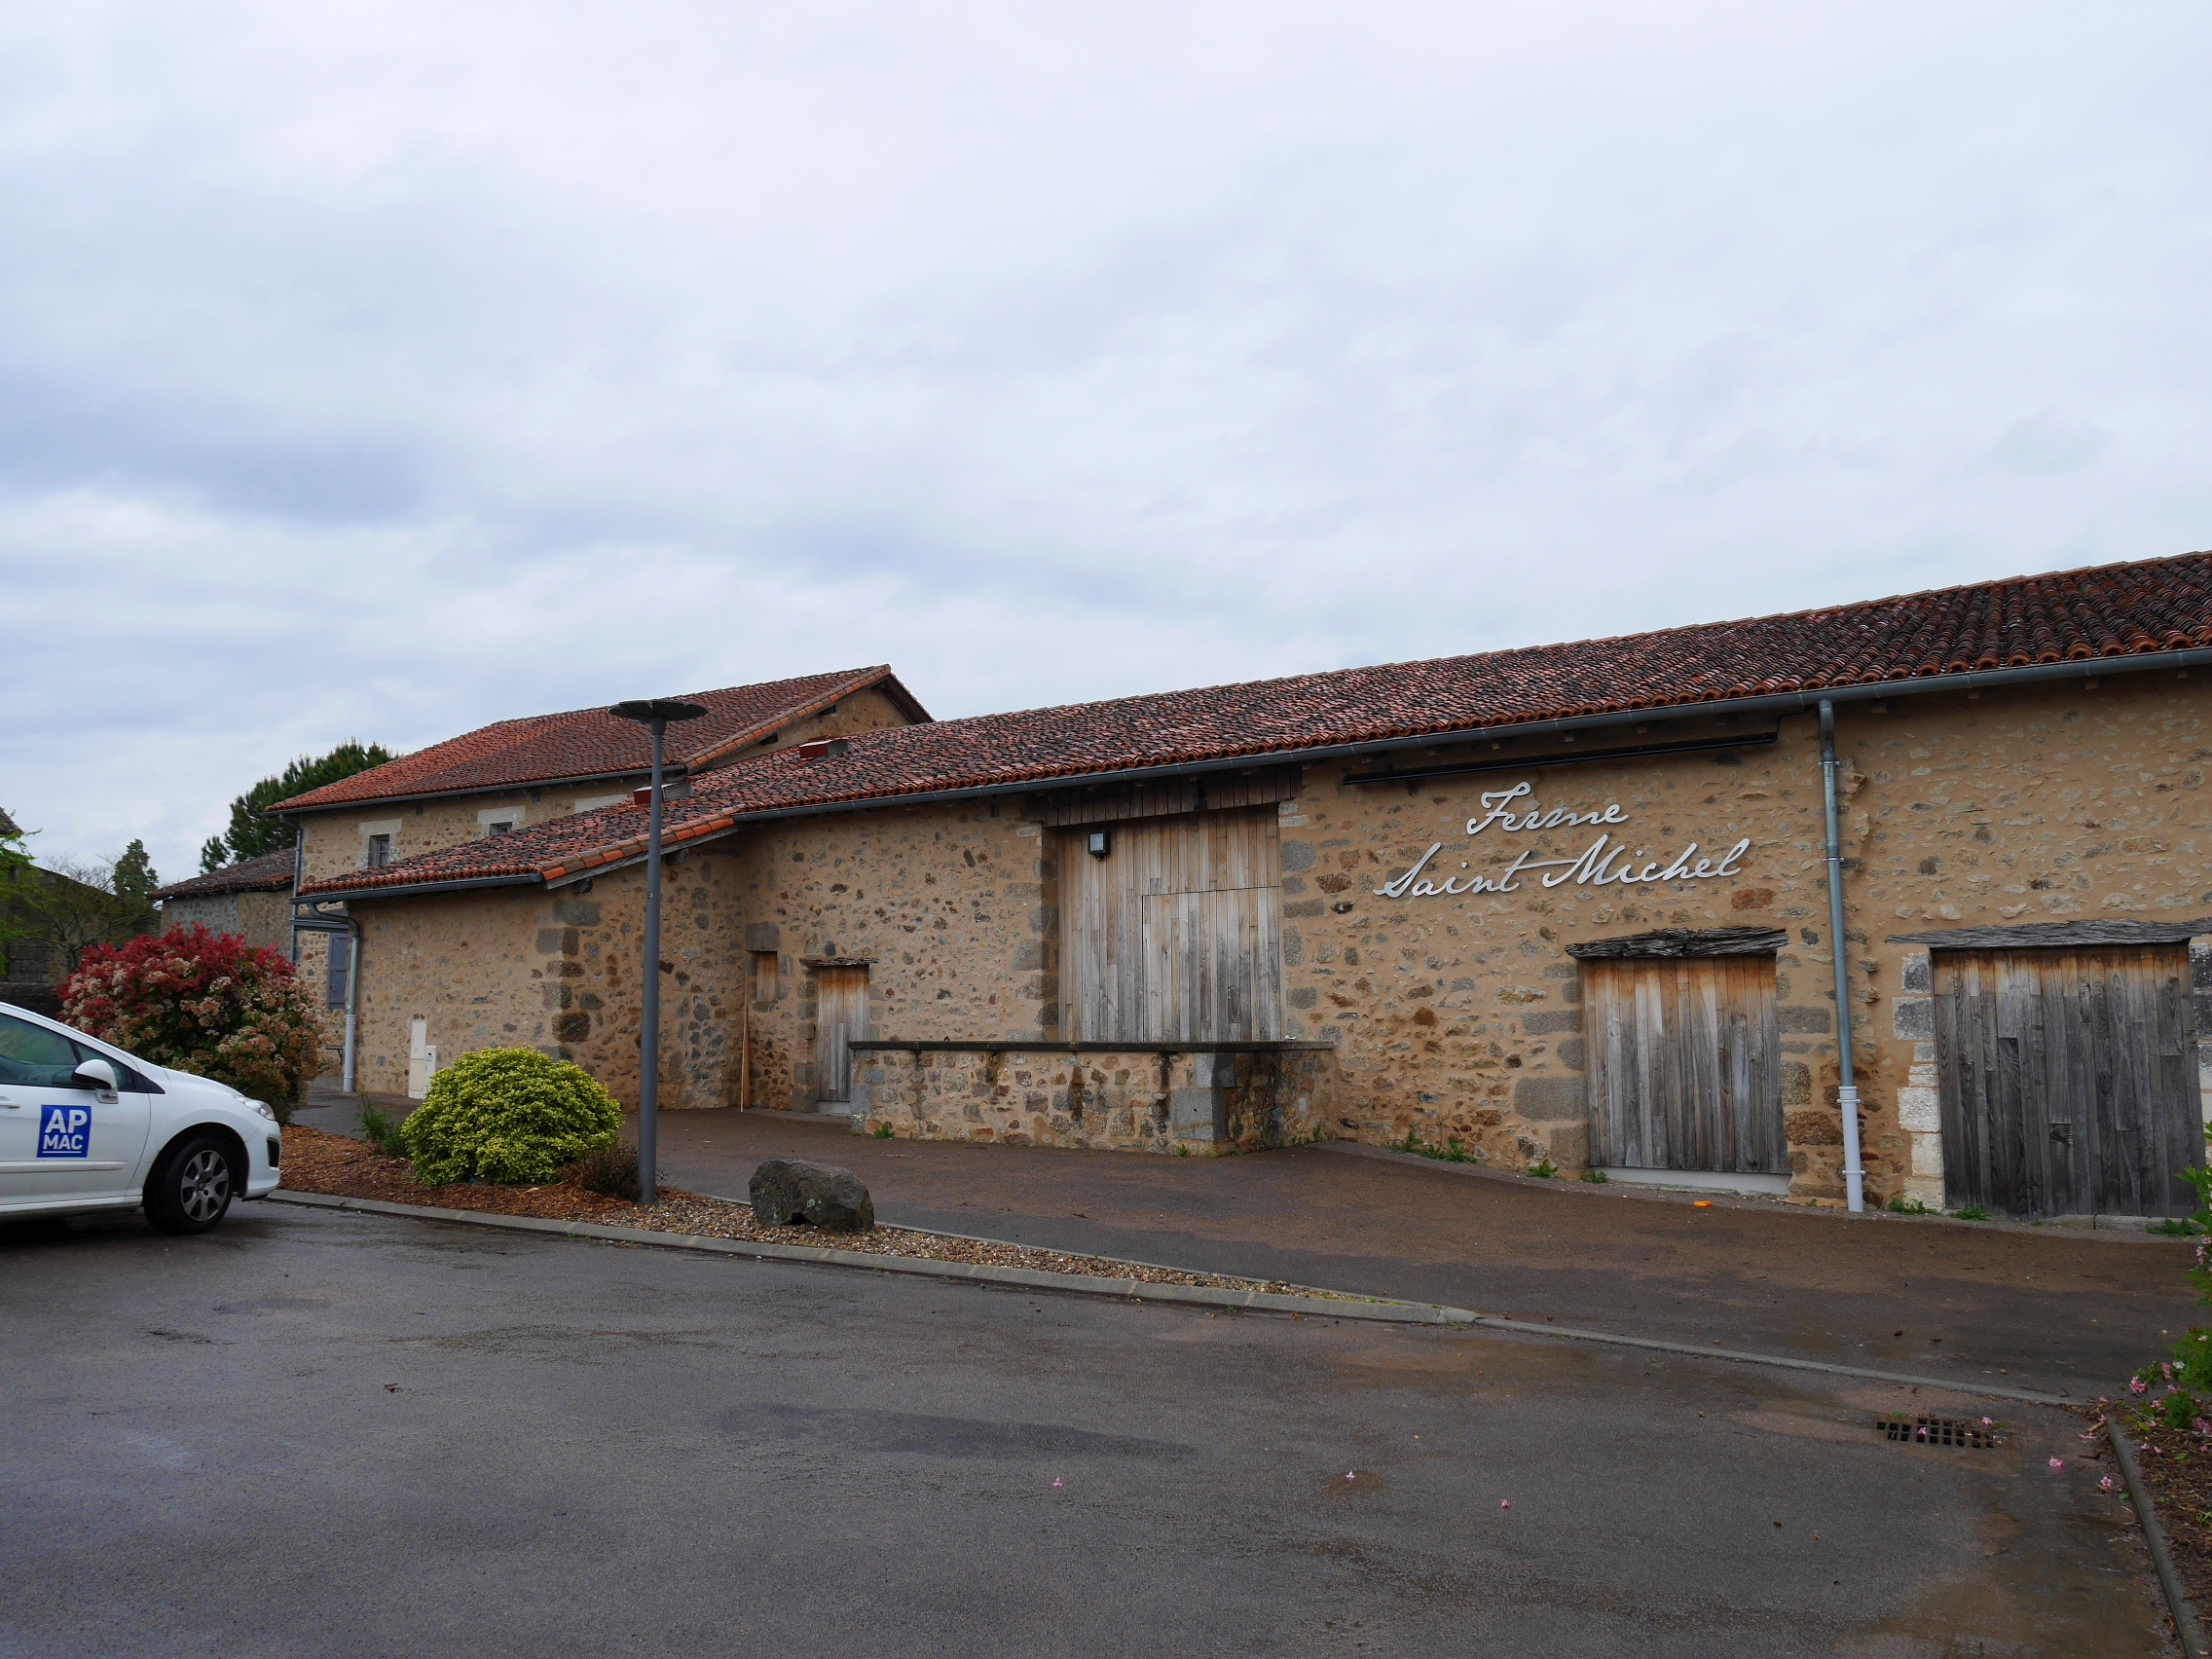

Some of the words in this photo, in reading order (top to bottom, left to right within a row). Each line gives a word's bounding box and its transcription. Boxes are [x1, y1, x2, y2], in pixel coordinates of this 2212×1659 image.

[1466, 781, 1629, 835] Ferme
[45, 1109, 88, 1134] AP
[43, 1134, 84, 1151] MAC
